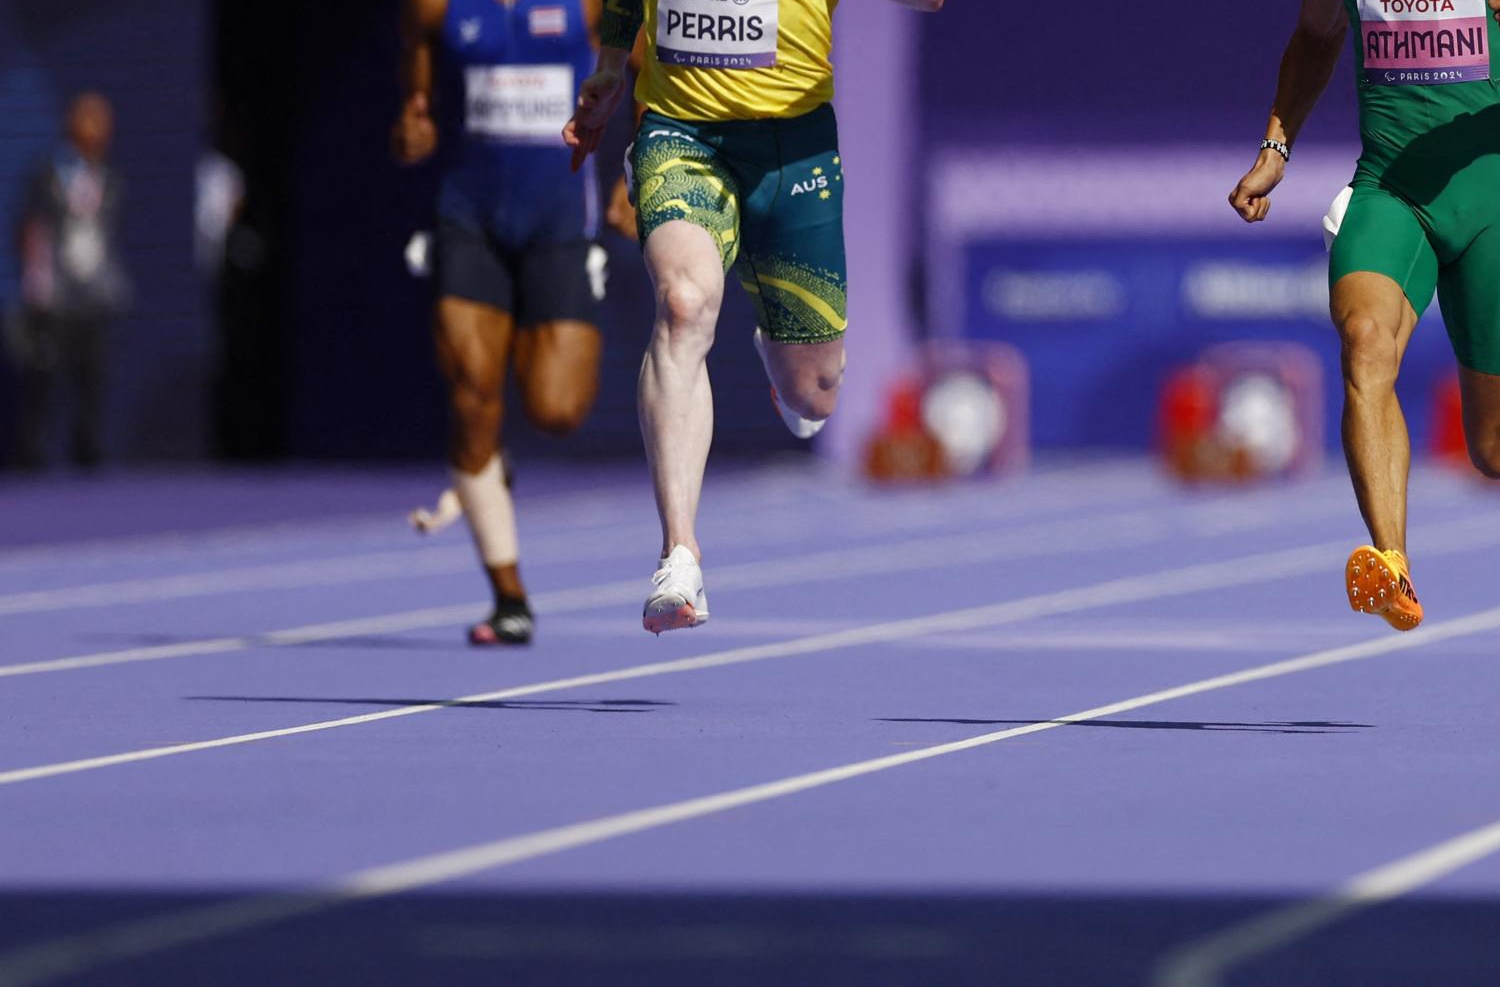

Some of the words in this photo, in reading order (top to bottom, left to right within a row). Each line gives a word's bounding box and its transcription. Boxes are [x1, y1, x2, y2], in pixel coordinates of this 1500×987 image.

[667, 8, 764, 42] PERRIS
[1366, 26, 1484, 60] ATHMANI
[690, 55, 721, 66] PARIS
[723, 56, 752, 66] 2024
[1400, 71, 1430, 81] PARIS
[1433, 70, 1463, 81] 2024
[790, 175, 829, 197] AUS
